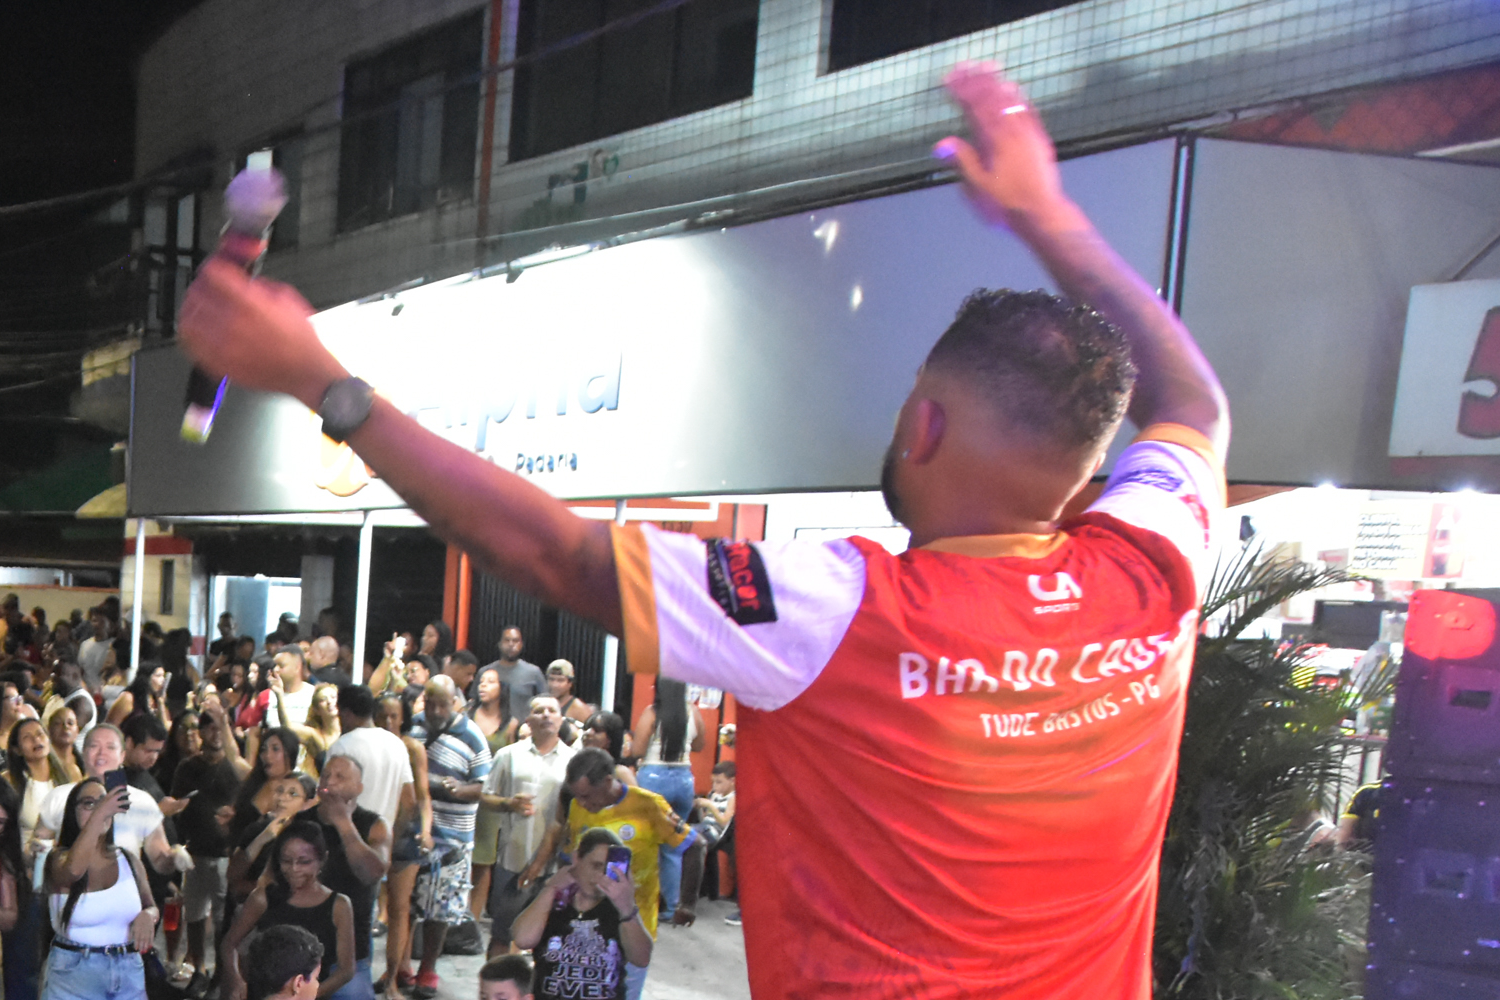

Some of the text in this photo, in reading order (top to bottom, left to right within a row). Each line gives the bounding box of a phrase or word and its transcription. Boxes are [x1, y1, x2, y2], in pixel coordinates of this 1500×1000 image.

[1001, 647, 1059, 692] DO
[979, 711, 1040, 738] TUDE
[552, 963, 608, 982] JEDI
[542, 976, 618, 1000] EVER
